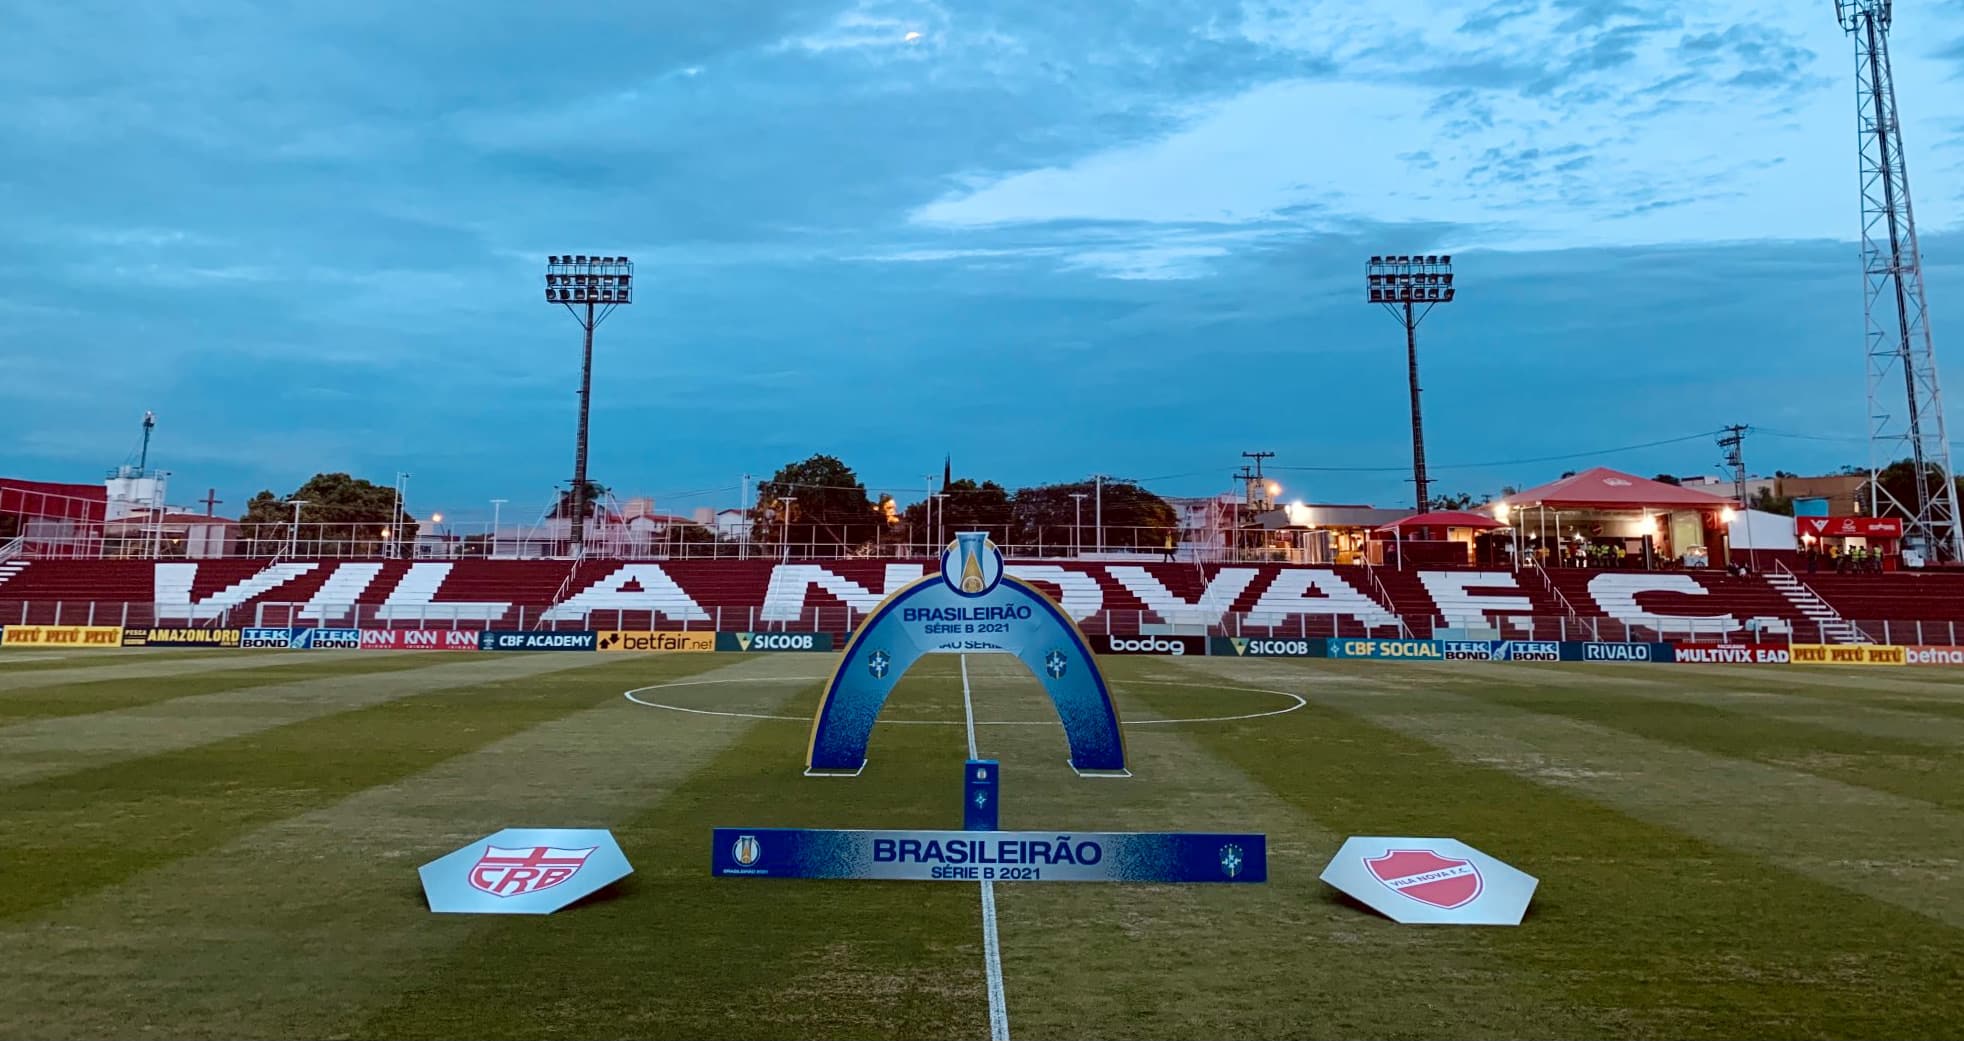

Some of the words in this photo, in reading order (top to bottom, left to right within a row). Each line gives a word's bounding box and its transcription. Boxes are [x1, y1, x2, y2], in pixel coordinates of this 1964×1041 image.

[154, 562, 711, 621] VILA
[903, 603, 1032, 622] BRASILEIRÃO
[147, 629, 240, 642] AMAZONLORD
[924, 622, 962, 634] SÉRIE
[965, 624, 975, 633] B
[978, 623, 1010, 633] 2021
[243, 640, 288, 648] BOND
[362, 630, 396, 643] KNN
[404, 631, 437, 644] KNN
[445, 631, 479, 644] KNN
[499, 635, 524, 647] CBF
[526, 635, 592, 647] ACADEMY
[624, 633, 712, 650] betfair.net
[754, 635, 813, 649] SICOOB
[1110, 634, 1185, 655] bodog
[1250, 640, 1308, 655] SICOOB
[1345, 641, 1375, 656] CBF
[1379, 642, 1441, 657] SOCIAL
[1588, 645, 1647, 660] RIVALO
[1446, 652, 1489, 660] BOND
[1513, 652, 1557, 661] BOND
[1676, 649, 1751, 663] MULTIVIX
[1756, 650, 1789, 663] EAD
[873, 835, 1102, 865] BRASILEIRÃO
[931, 863, 979, 879] SÉRIE
[983, 867, 995, 879] B
[999, 867, 1041, 879] 2021
[474, 867, 572, 893] CRB
